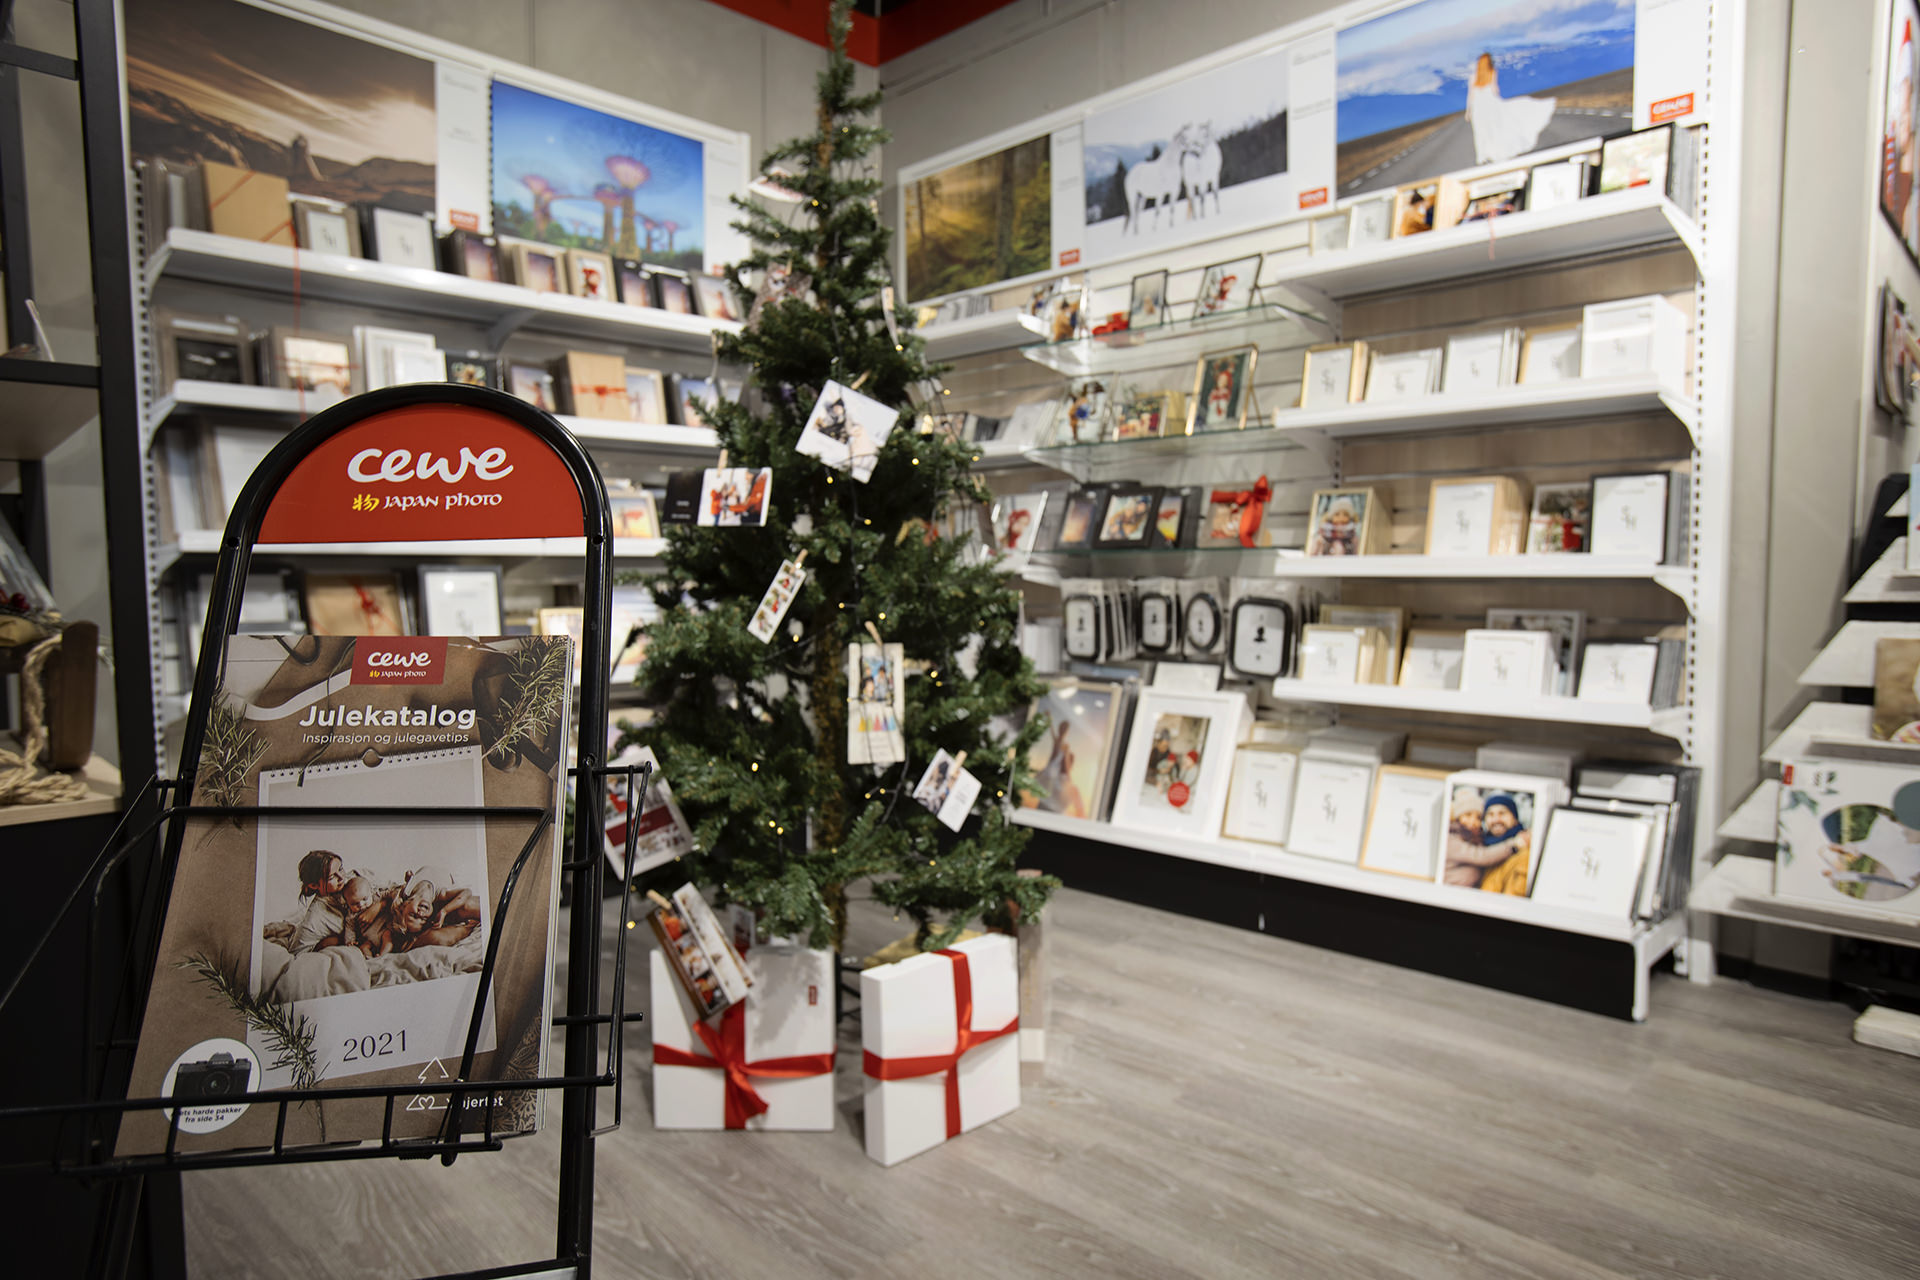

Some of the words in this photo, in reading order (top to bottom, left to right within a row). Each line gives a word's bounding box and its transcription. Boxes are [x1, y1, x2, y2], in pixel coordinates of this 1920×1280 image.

[347, 446, 514, 484] cewe
[367, 651, 432, 668] cewe
[299, 704, 477, 730] Julekatalog
[302, 733, 371, 745] Inspirasjon
[374, 735, 391, 744] og
[394, 732, 469, 745] julegavetips
[342, 1029, 406, 1062] 2021
[192, 1107, 214, 1115] harde
[216, 1107, 242, 1115] pakker
